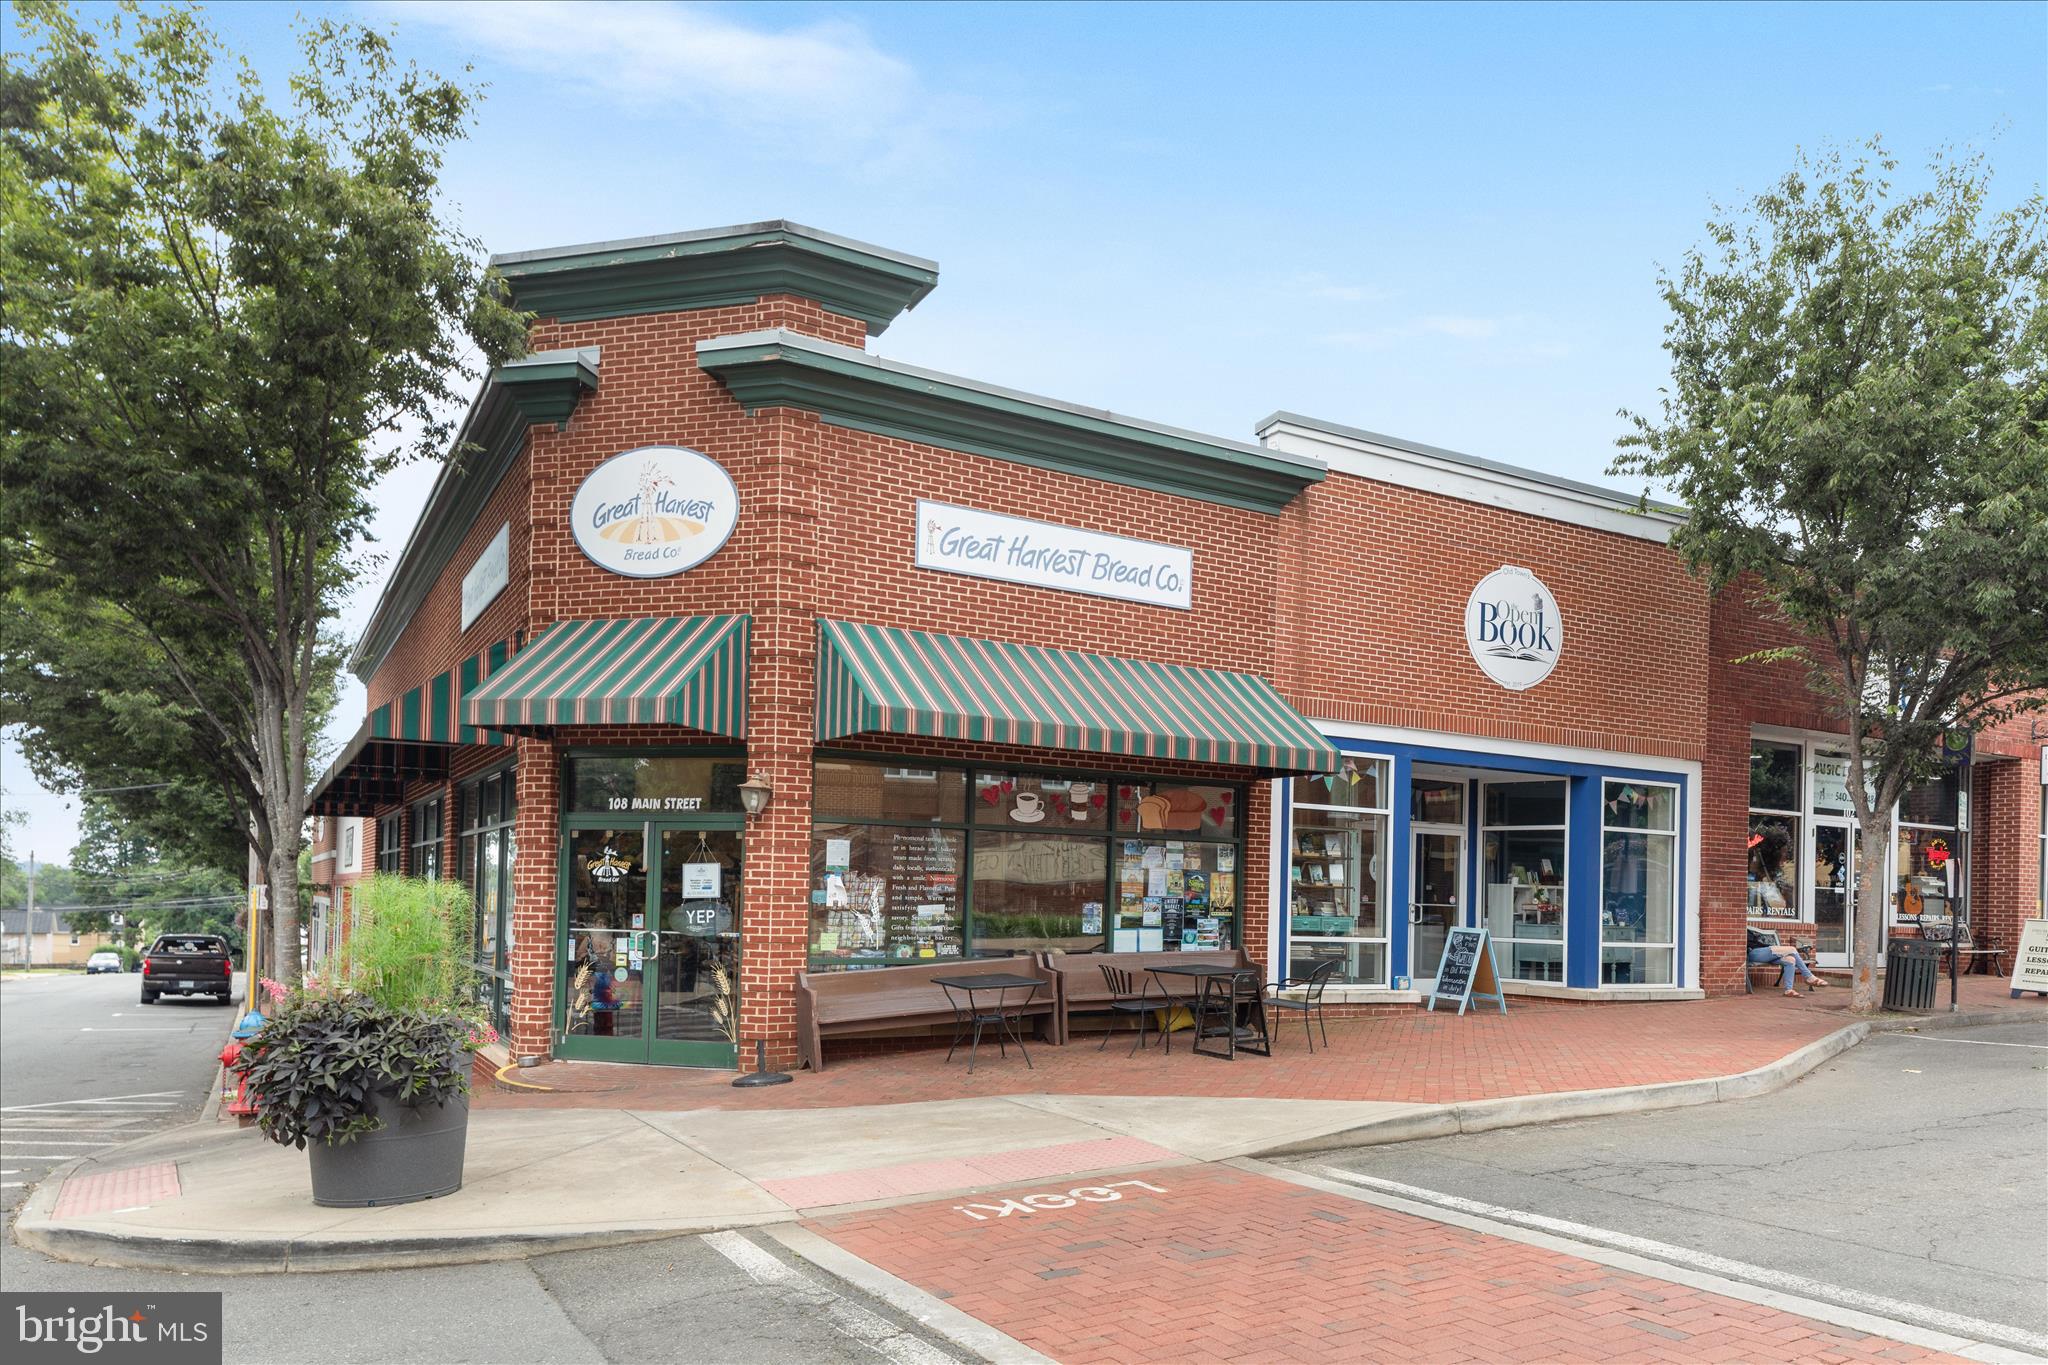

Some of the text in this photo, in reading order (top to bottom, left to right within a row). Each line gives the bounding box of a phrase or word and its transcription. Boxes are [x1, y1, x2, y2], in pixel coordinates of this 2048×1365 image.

[593, 490, 715, 529] Great Harvest
[624, 547, 659, 561] Bread
[940, 527, 1184, 592] Great Harvest Bread Co.
[1497, 600, 1538, 628] Open
[1477, 602, 1554, 652] Book
[608, 797, 702, 810] 108 MAIN STREET
[1843, 808, 1855, 818] 102
[587, 857, 632, 871] Great Harvest
[686, 910, 716, 925] YEP
[1766, 906, 1796, 916] RENTALS
[1896, 913, 1917, 921] LESSONS
[953, 1180, 1172, 1220] LOOK!
